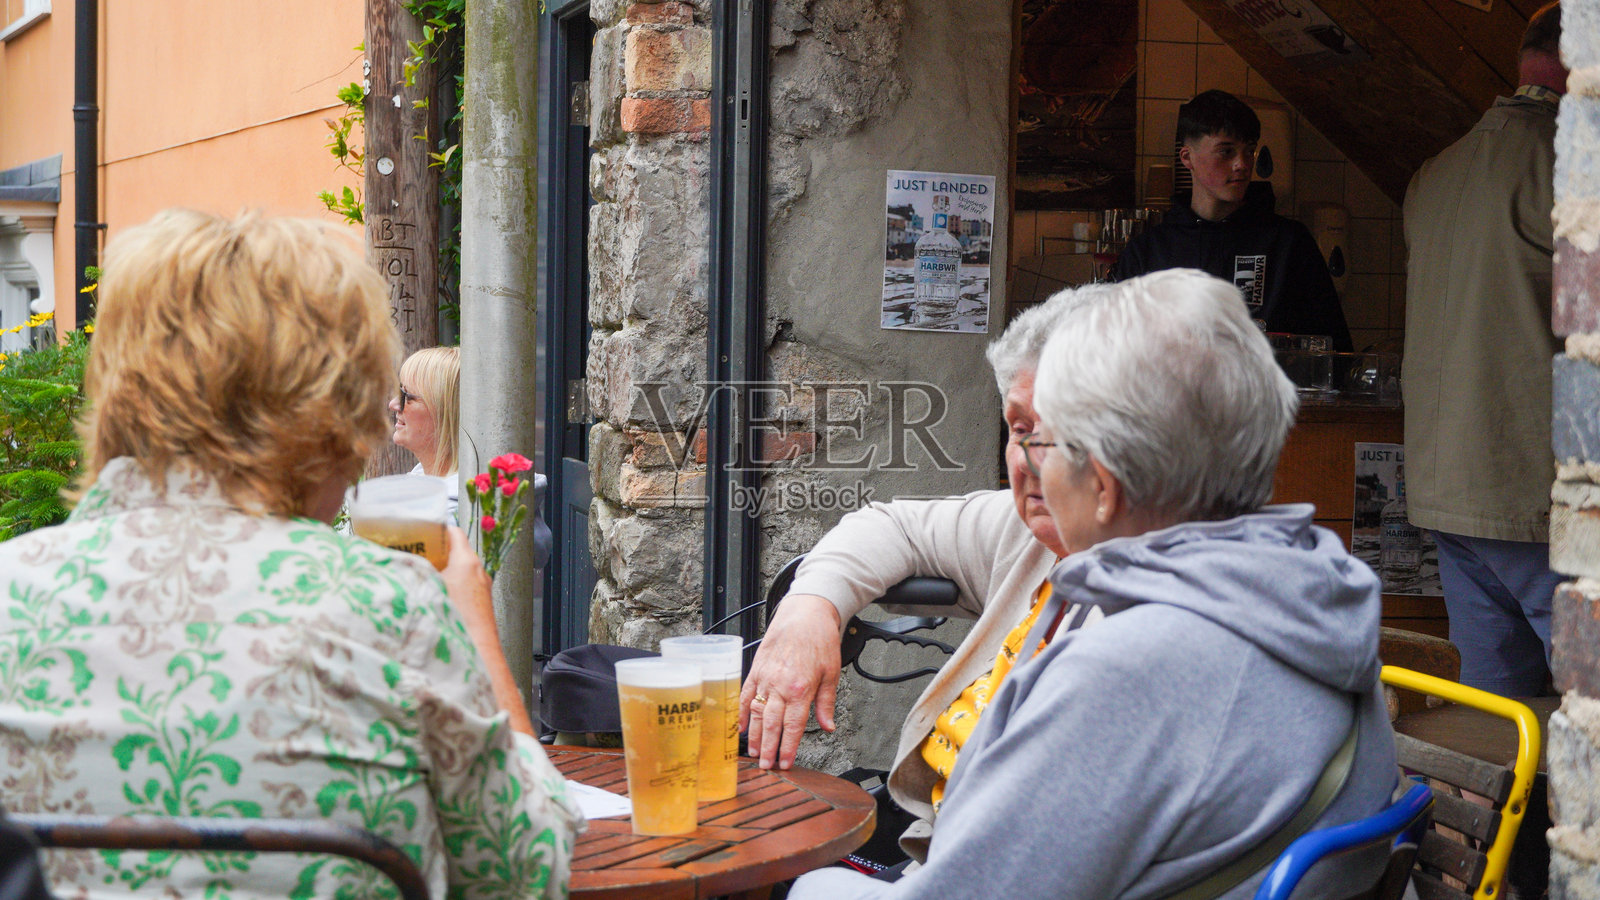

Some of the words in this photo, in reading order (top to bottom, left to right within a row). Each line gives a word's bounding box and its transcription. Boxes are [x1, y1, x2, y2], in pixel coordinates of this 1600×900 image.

[894, 179, 928, 191] JUST
[932, 180, 988, 195] LANDED
[381, 218, 417, 241] BT
[920, 262, 956, 272] HARBWR
[1253, 257, 1264, 304] HARBWR
[1360, 450, 1392, 462] JUST
[1395, 452, 1405, 463] L
[1386, 530, 1420, 539] HARBWR
